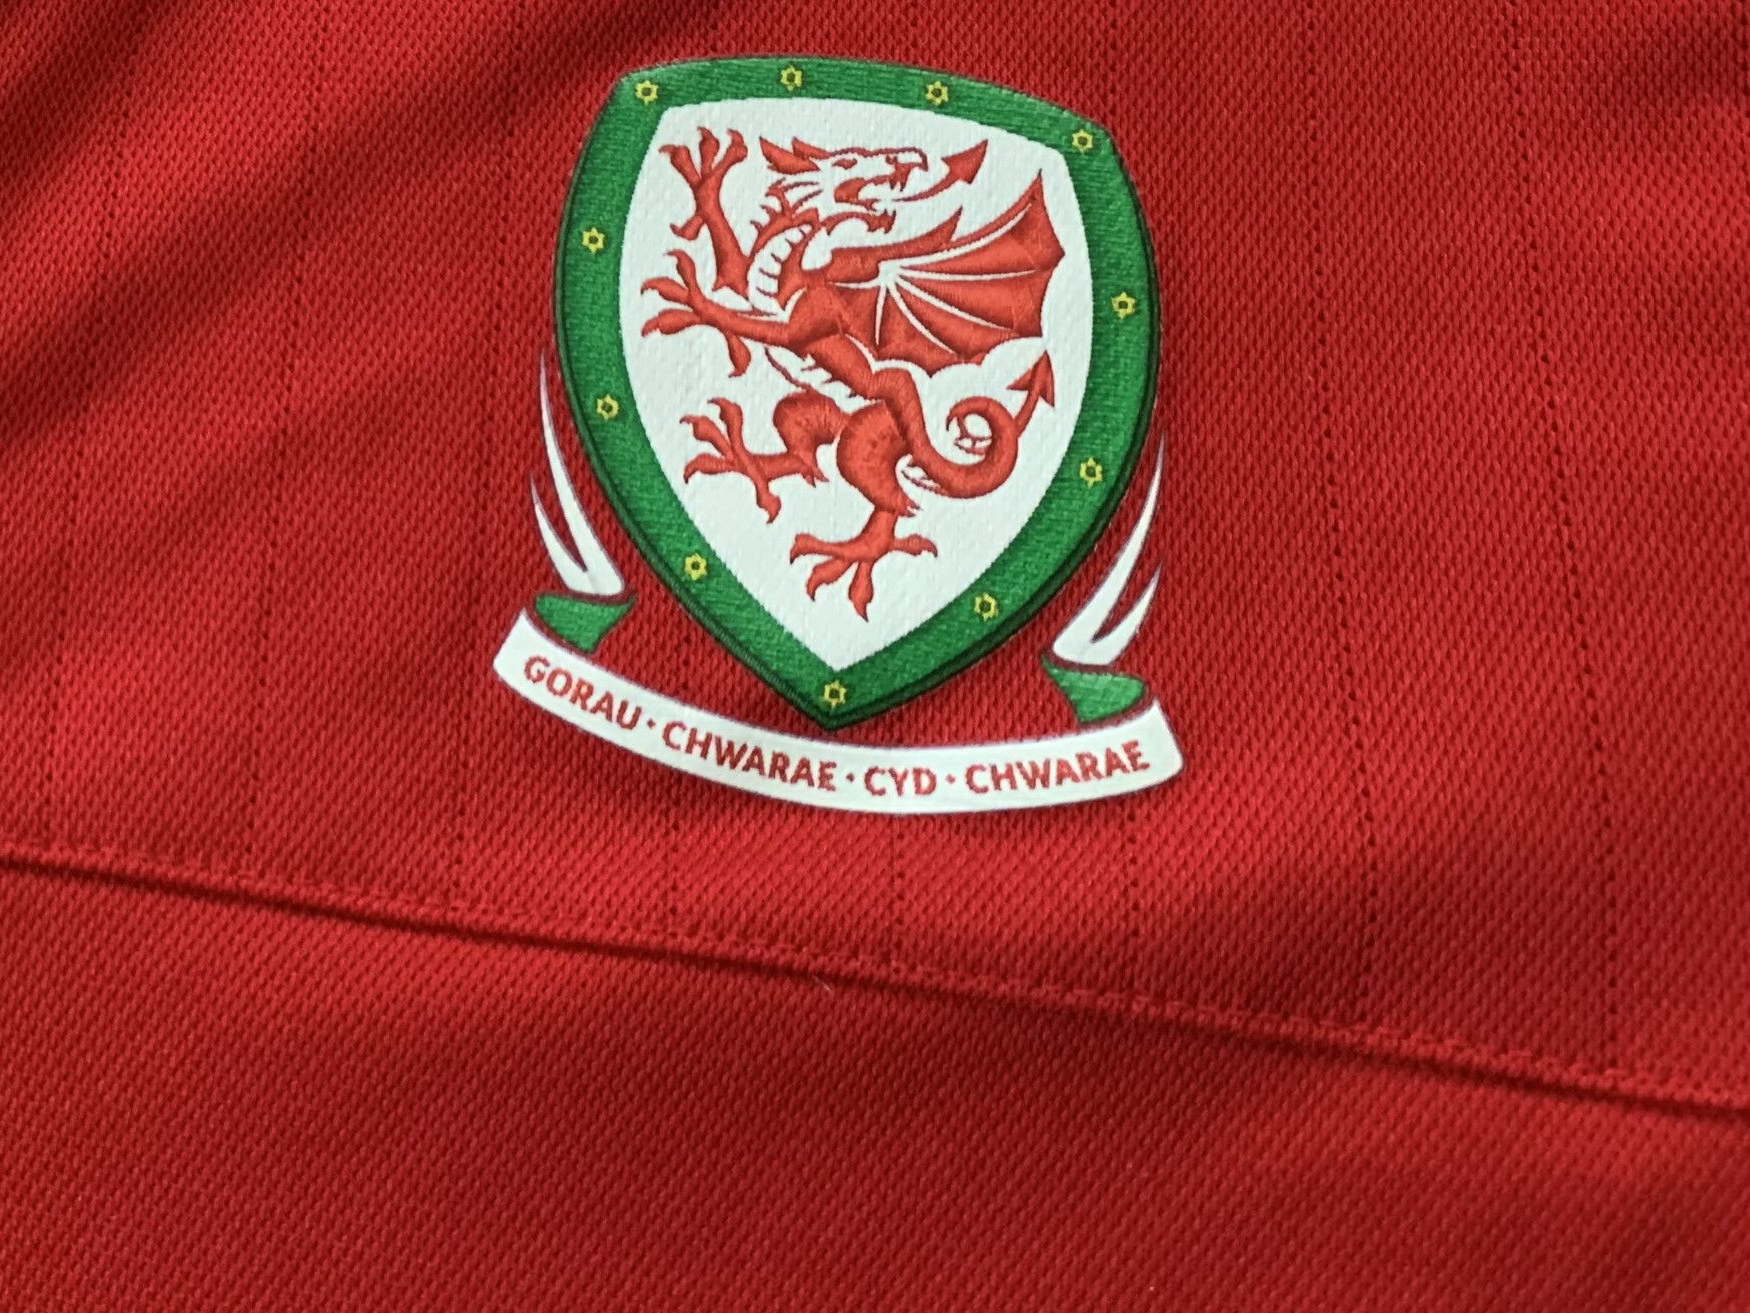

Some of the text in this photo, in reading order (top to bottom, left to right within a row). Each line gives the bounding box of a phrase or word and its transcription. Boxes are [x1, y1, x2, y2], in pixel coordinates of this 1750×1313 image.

[523, 654, 1151, 797] GORAU CHWARAE CYD CHWARAE
